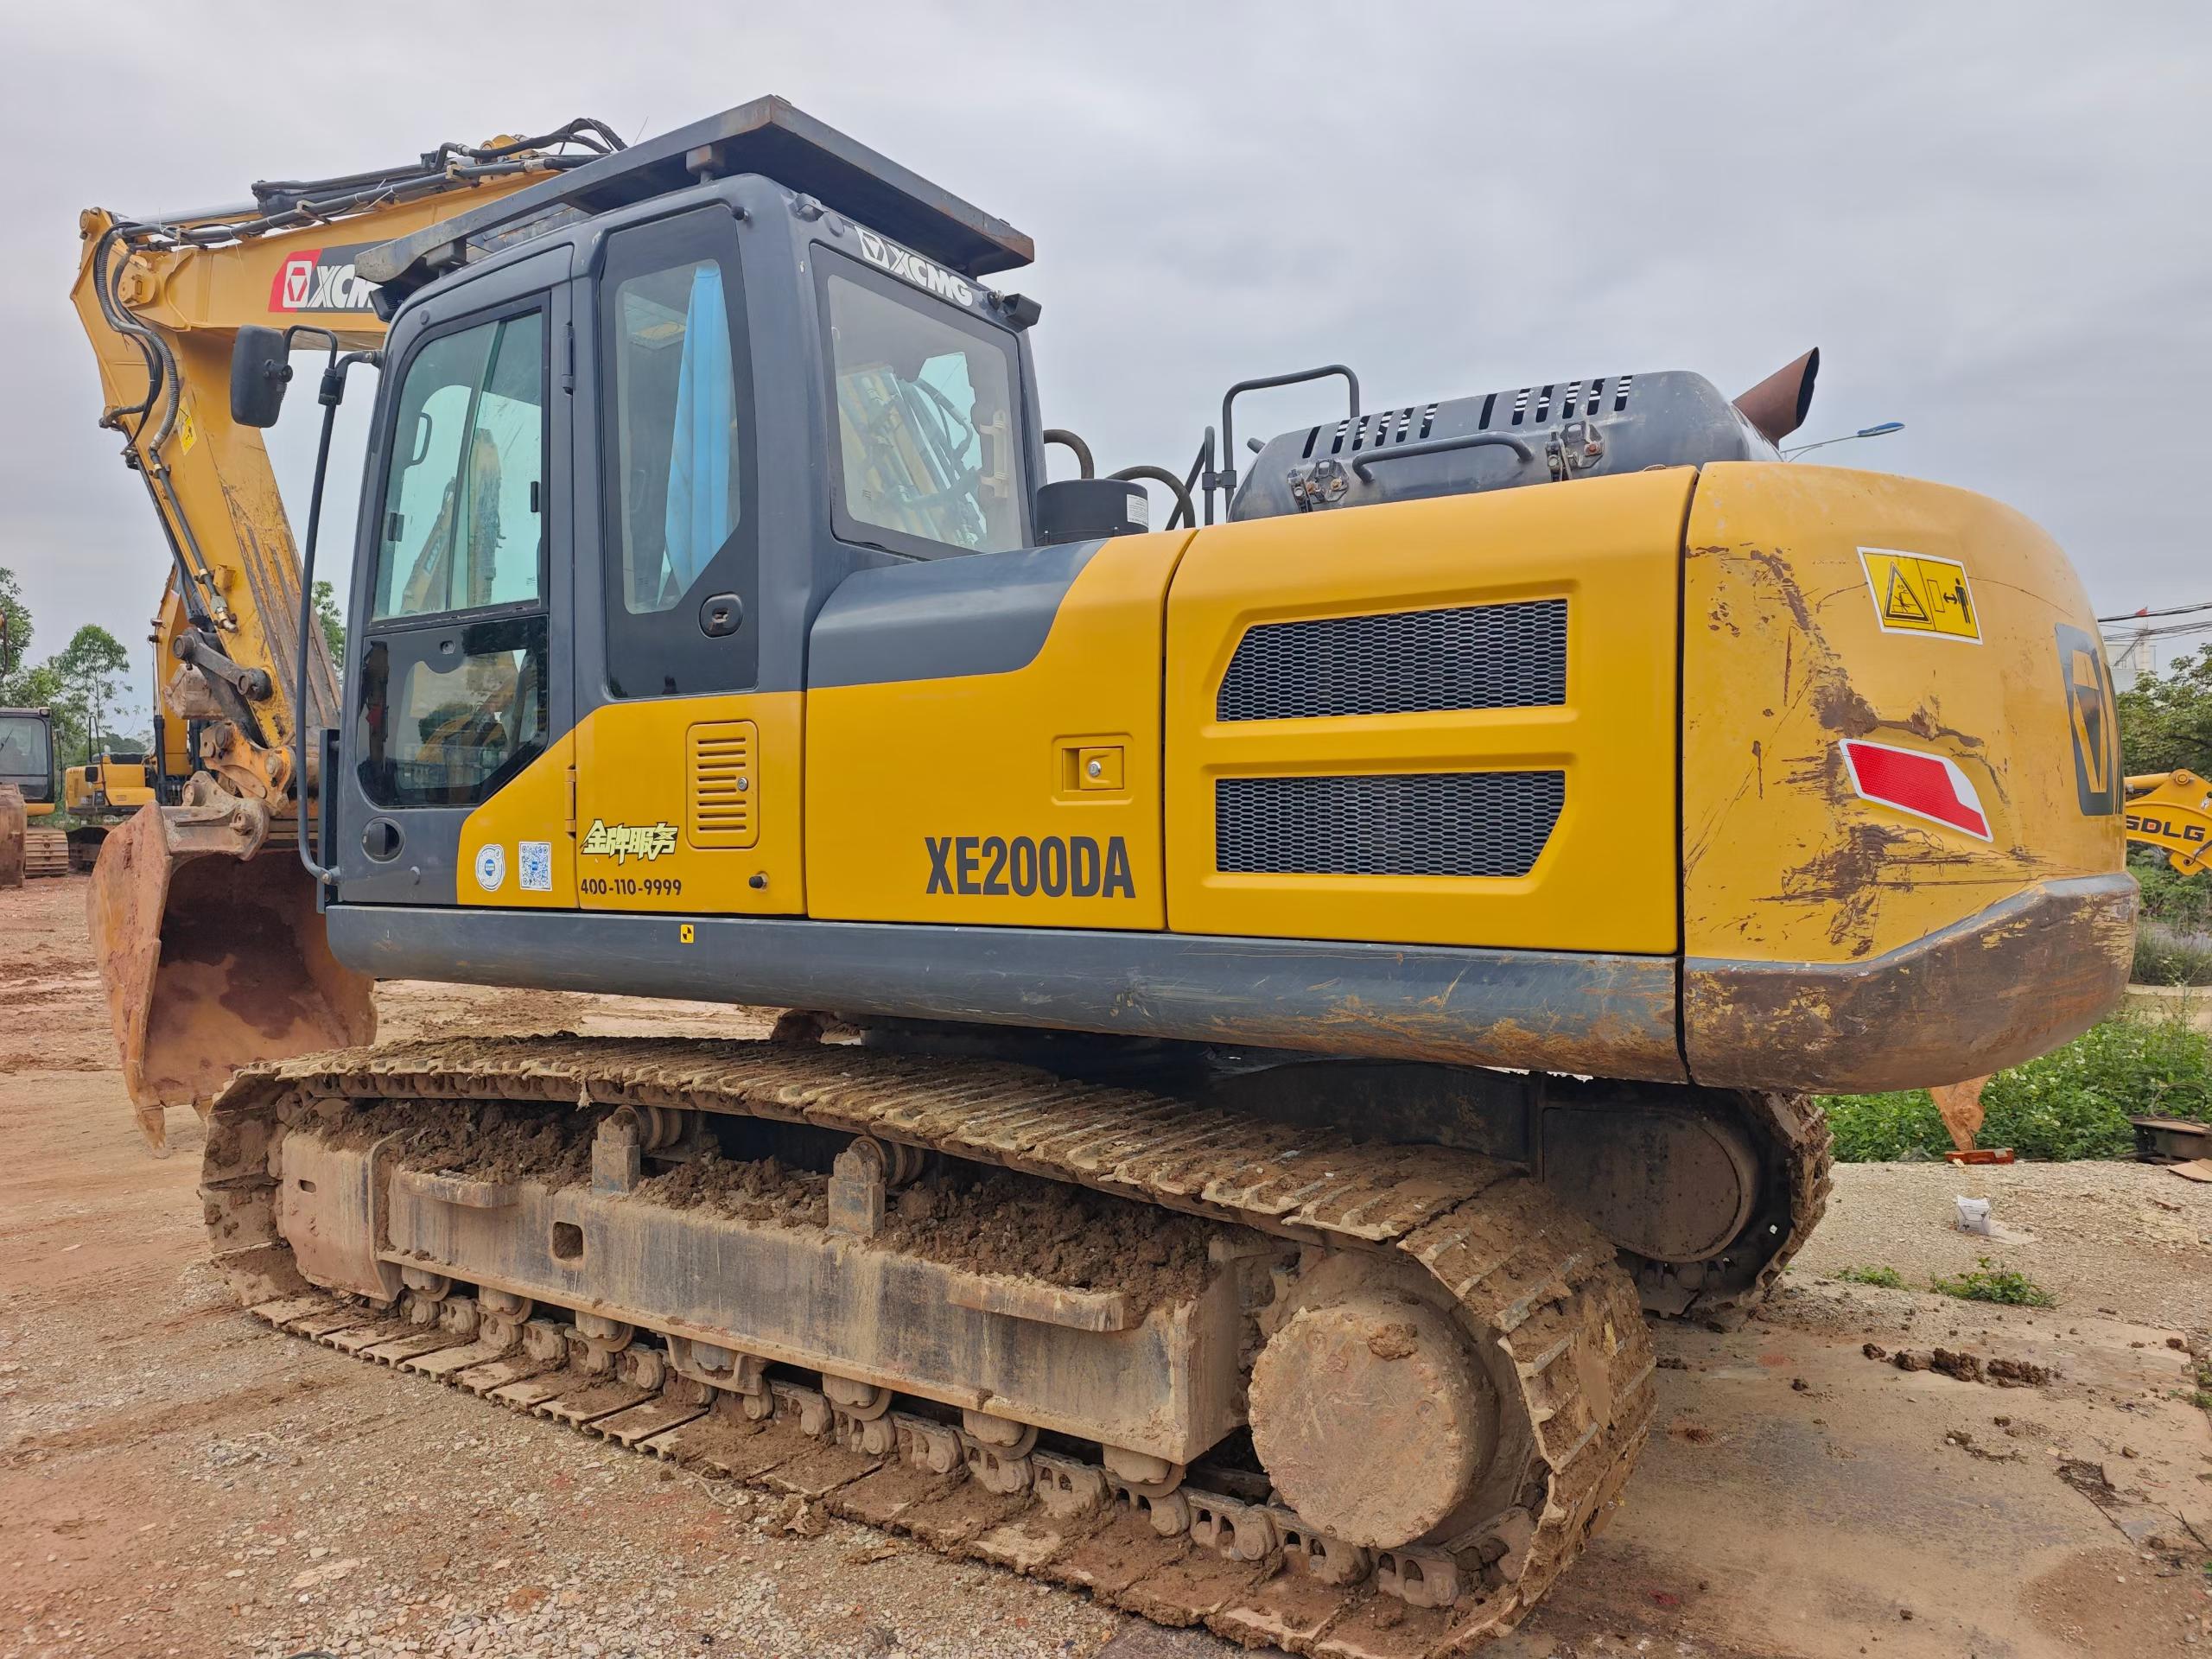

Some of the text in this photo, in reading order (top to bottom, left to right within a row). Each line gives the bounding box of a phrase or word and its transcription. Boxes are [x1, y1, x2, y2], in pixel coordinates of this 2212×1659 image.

[887, 243, 973, 307] XCMG
[580, 819, 679, 866] 金牌服务
[2126, 815, 2205, 842] SDLG
[581, 879, 682, 896] 400-110-9999
[925, 836, 1136, 899] XE200DA
